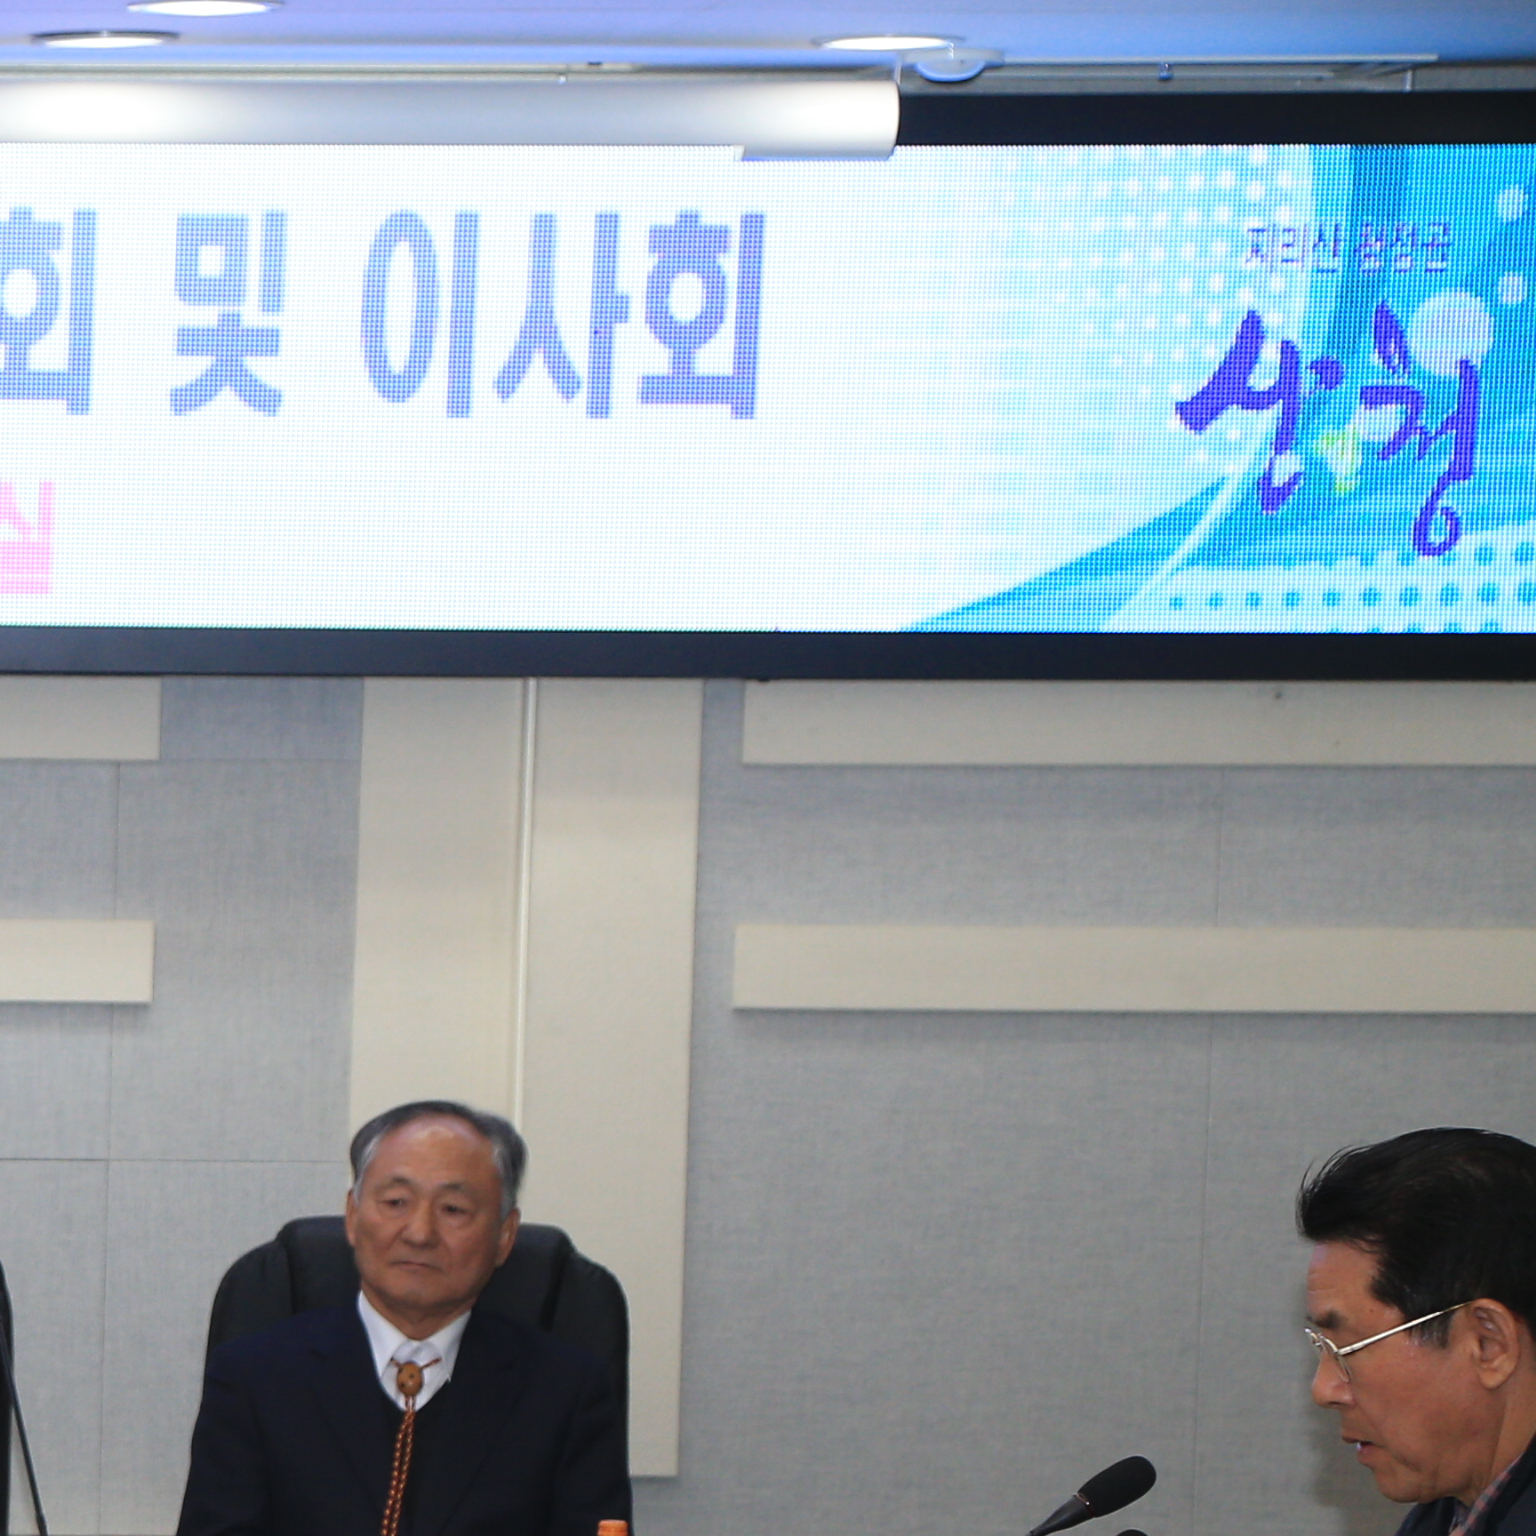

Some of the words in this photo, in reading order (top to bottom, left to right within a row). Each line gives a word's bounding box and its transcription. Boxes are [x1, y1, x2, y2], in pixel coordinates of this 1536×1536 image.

[169, 208, 287, 416] 및
[360, 210, 767, 419] 이사회
[1174, 300, 1483, 557] 산청
